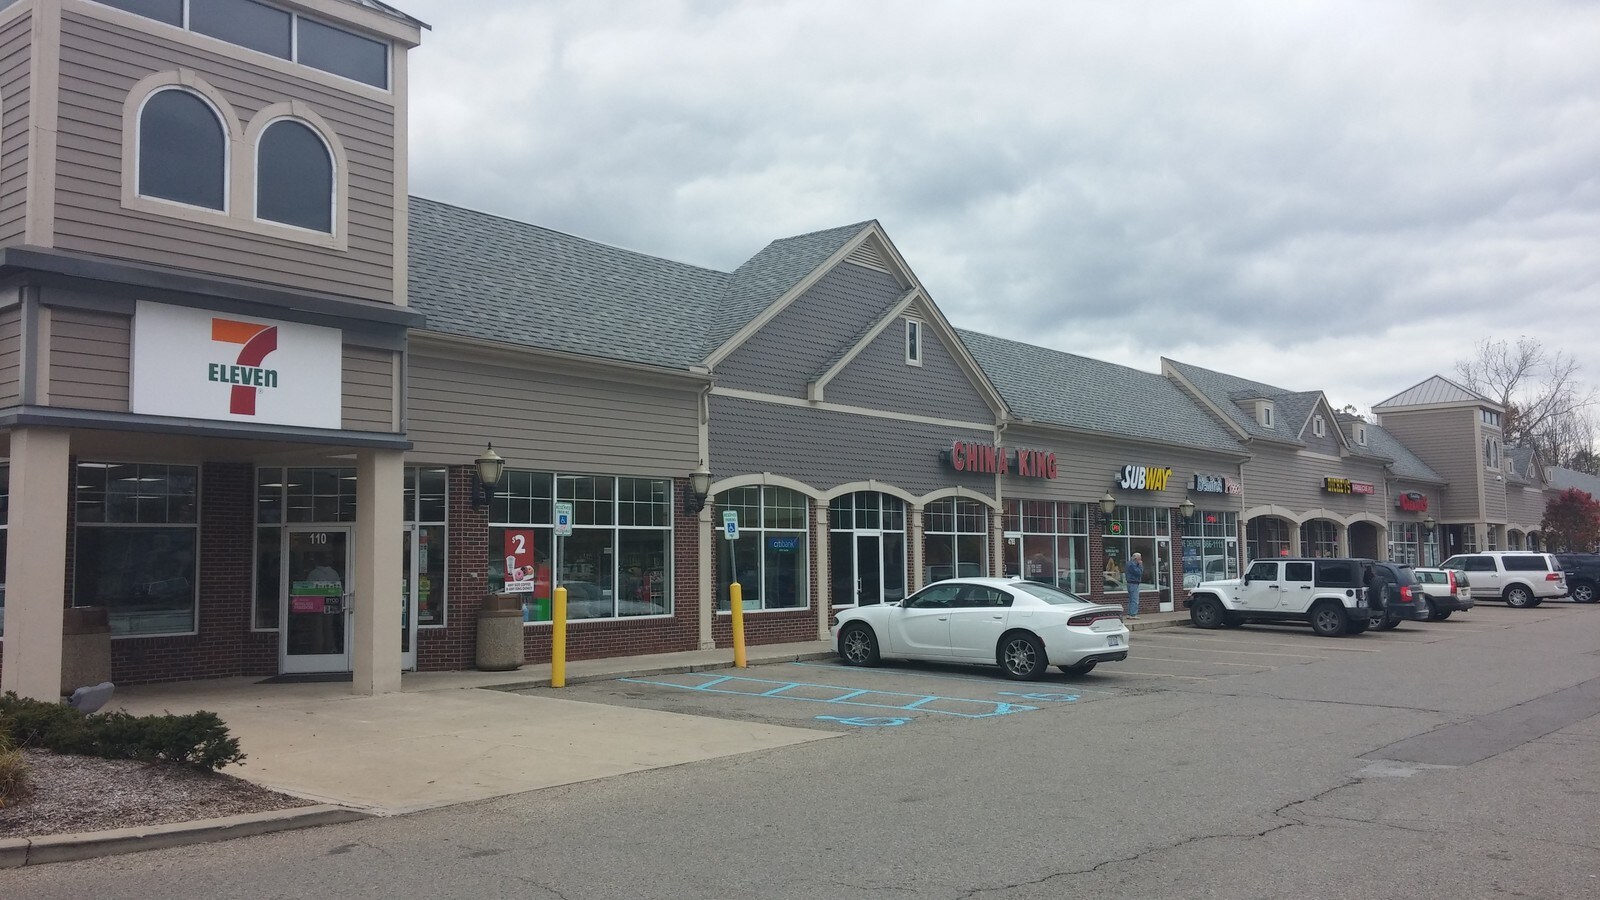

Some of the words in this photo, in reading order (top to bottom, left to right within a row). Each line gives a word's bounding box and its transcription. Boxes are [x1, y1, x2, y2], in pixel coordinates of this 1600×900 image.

[952, 440, 1009, 474] CHINA
[1018, 448, 1057, 479] KING
[1121, 464, 1173, 491] SUBWAY
[310, 532, 327, 545] 110
[511, 534, 526, 554] $2
[773, 540, 795, 548] citibank
